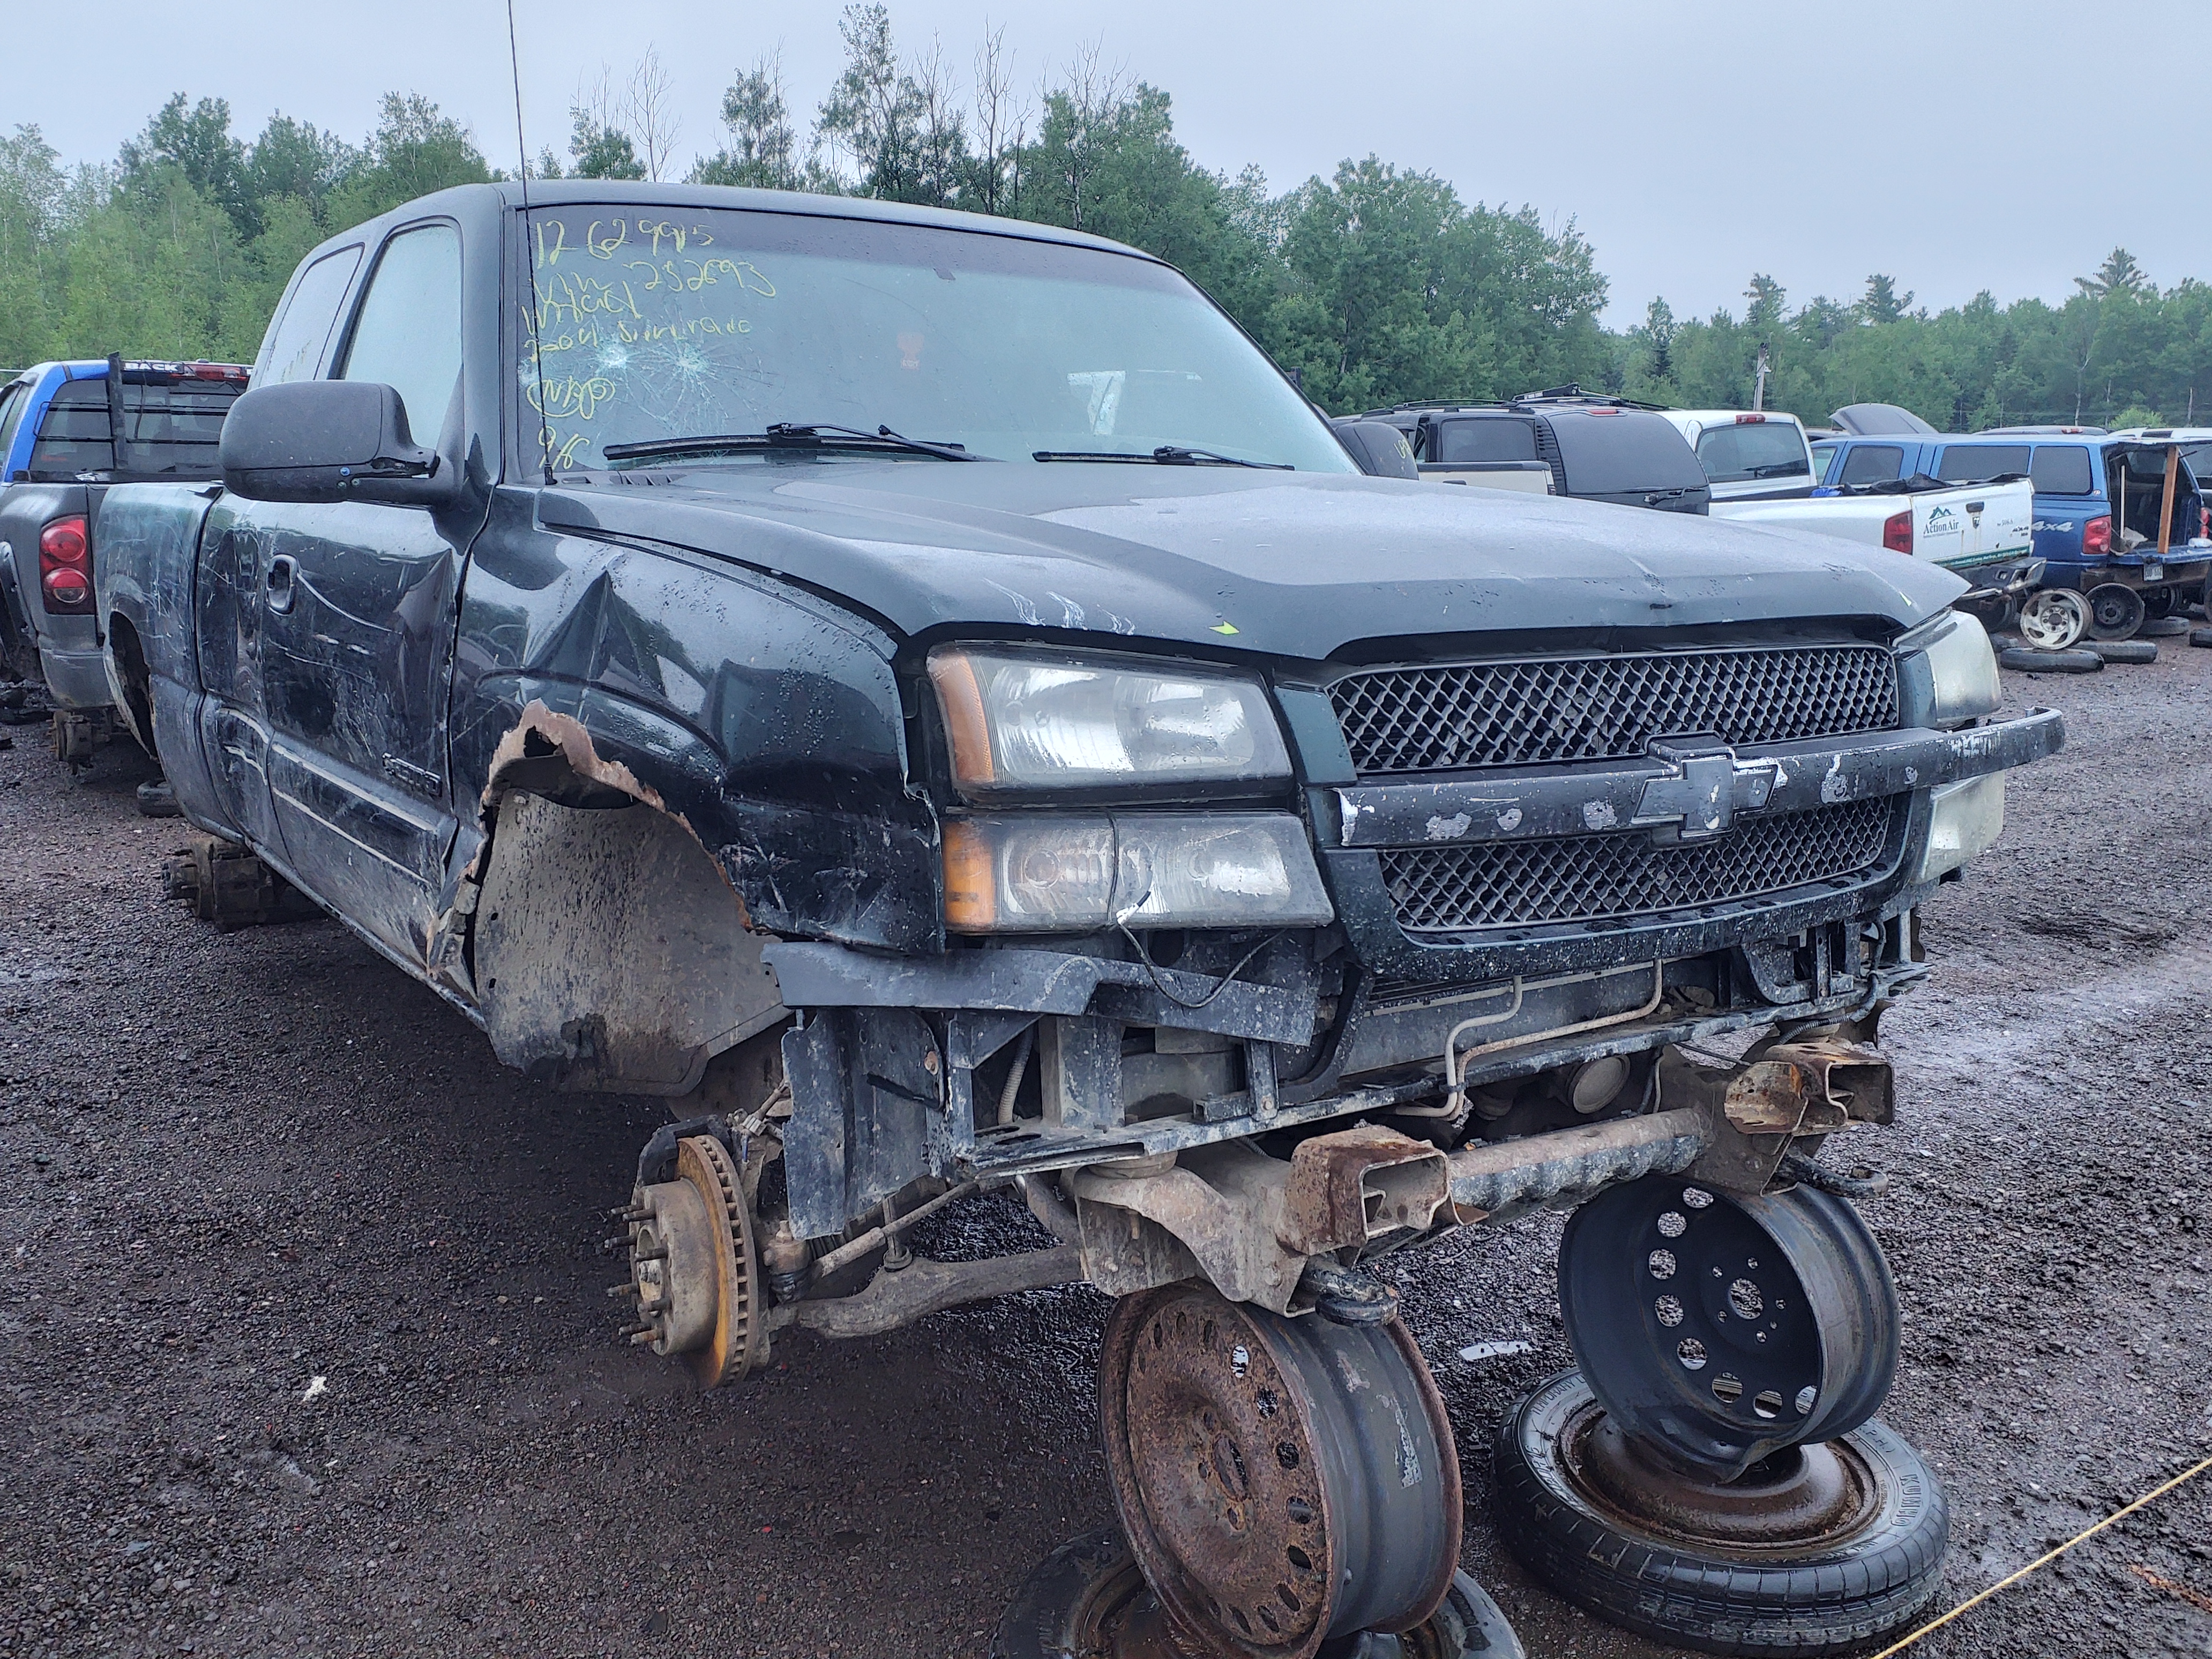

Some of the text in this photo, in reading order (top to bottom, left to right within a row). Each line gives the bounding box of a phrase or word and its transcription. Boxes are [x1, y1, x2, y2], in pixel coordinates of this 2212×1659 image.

[124, 362, 178, 371] BACK
[1924, 522, 1947, 535] Action
[1948, 519, 1959, 530] Air
[1890, 1474, 1922, 1527] KUMHO
